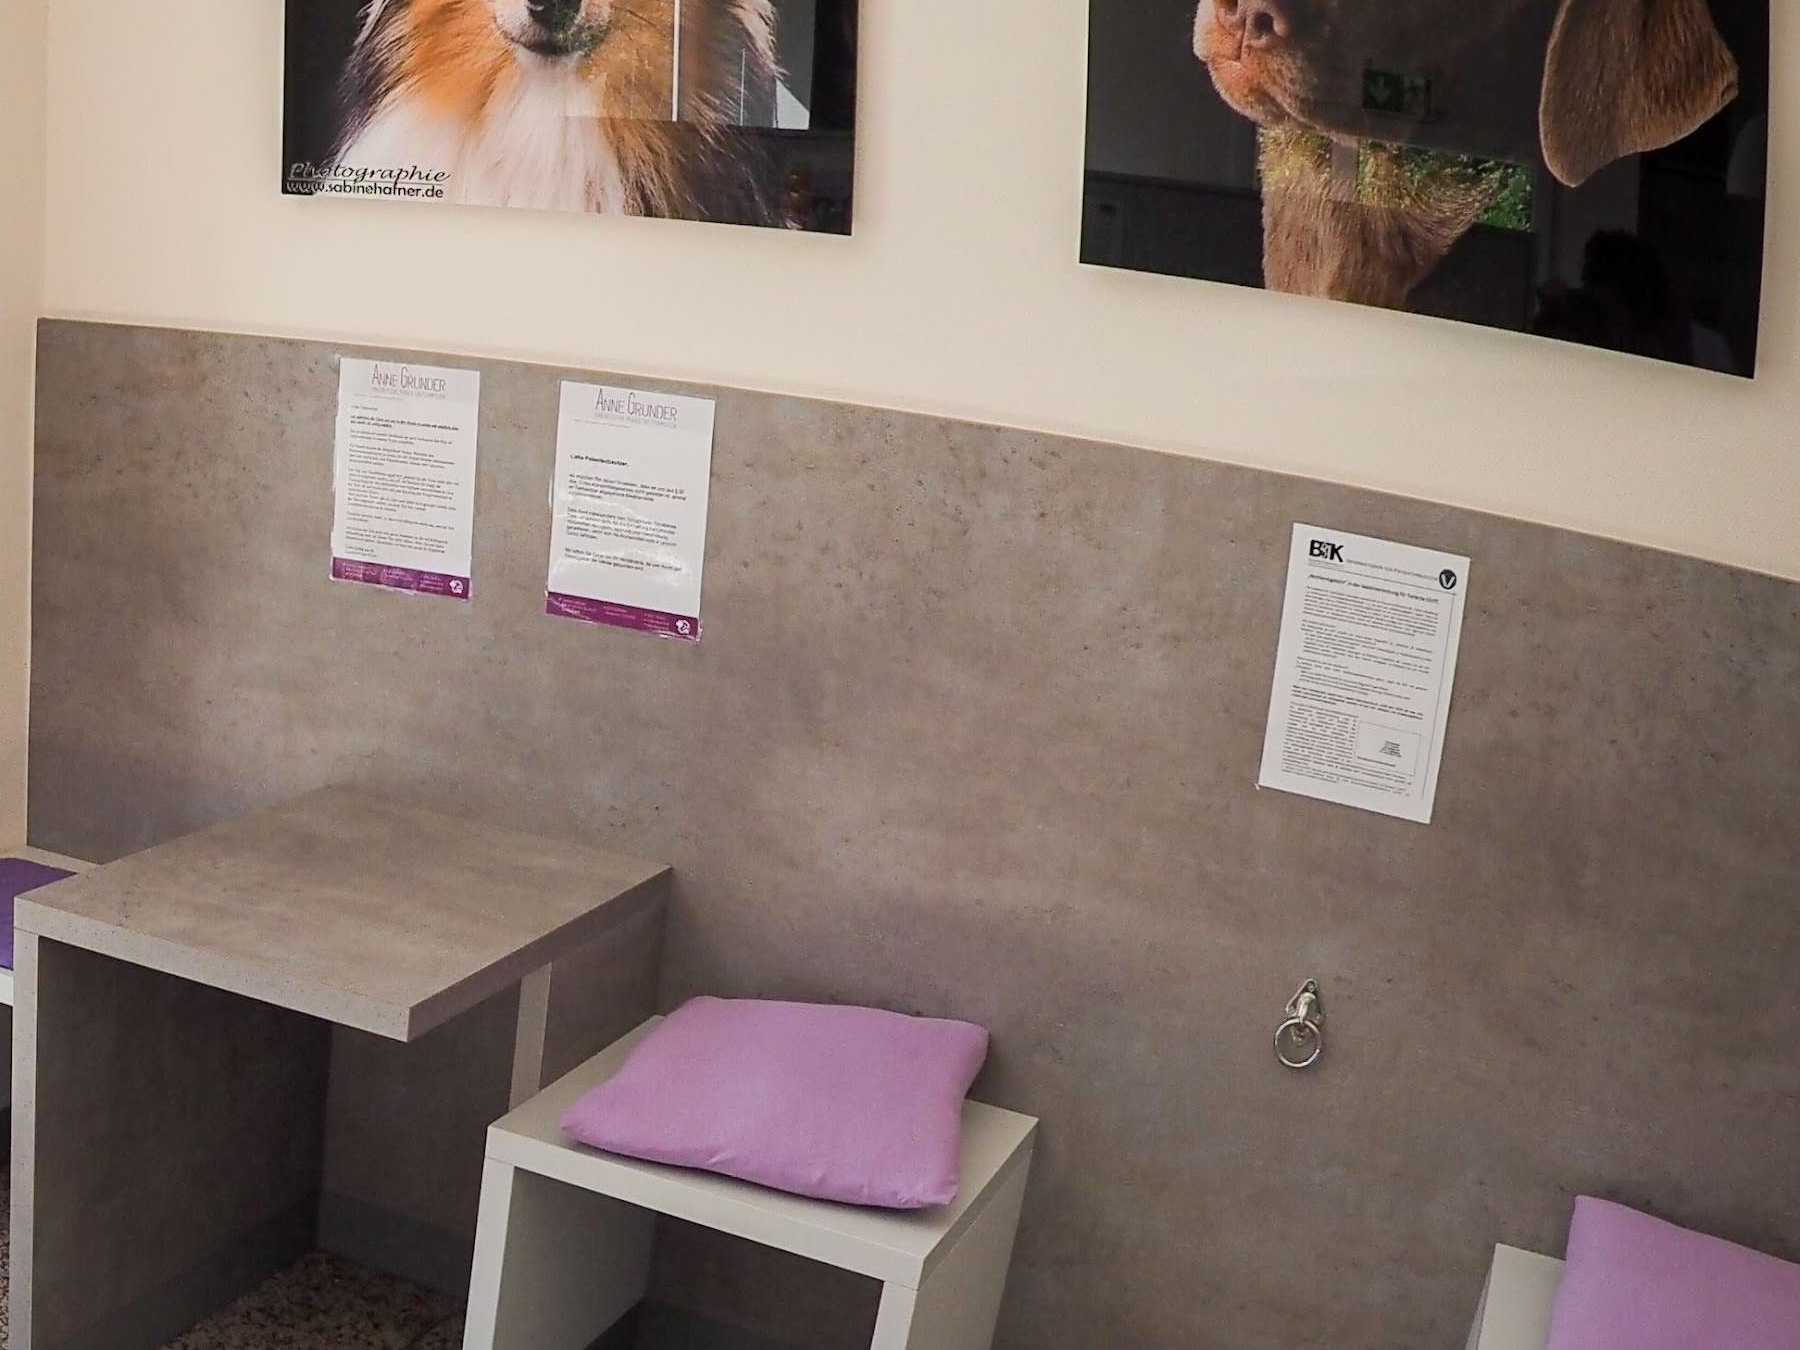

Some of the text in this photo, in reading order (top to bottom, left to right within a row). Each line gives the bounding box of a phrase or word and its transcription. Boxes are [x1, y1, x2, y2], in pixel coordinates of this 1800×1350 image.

[288, 161, 452, 186] Photographie
[286, 180, 445, 199] www.sabinehafner.de
[370, 363, 398, 388] ANNE
[595, 387, 626, 415] ANNE
